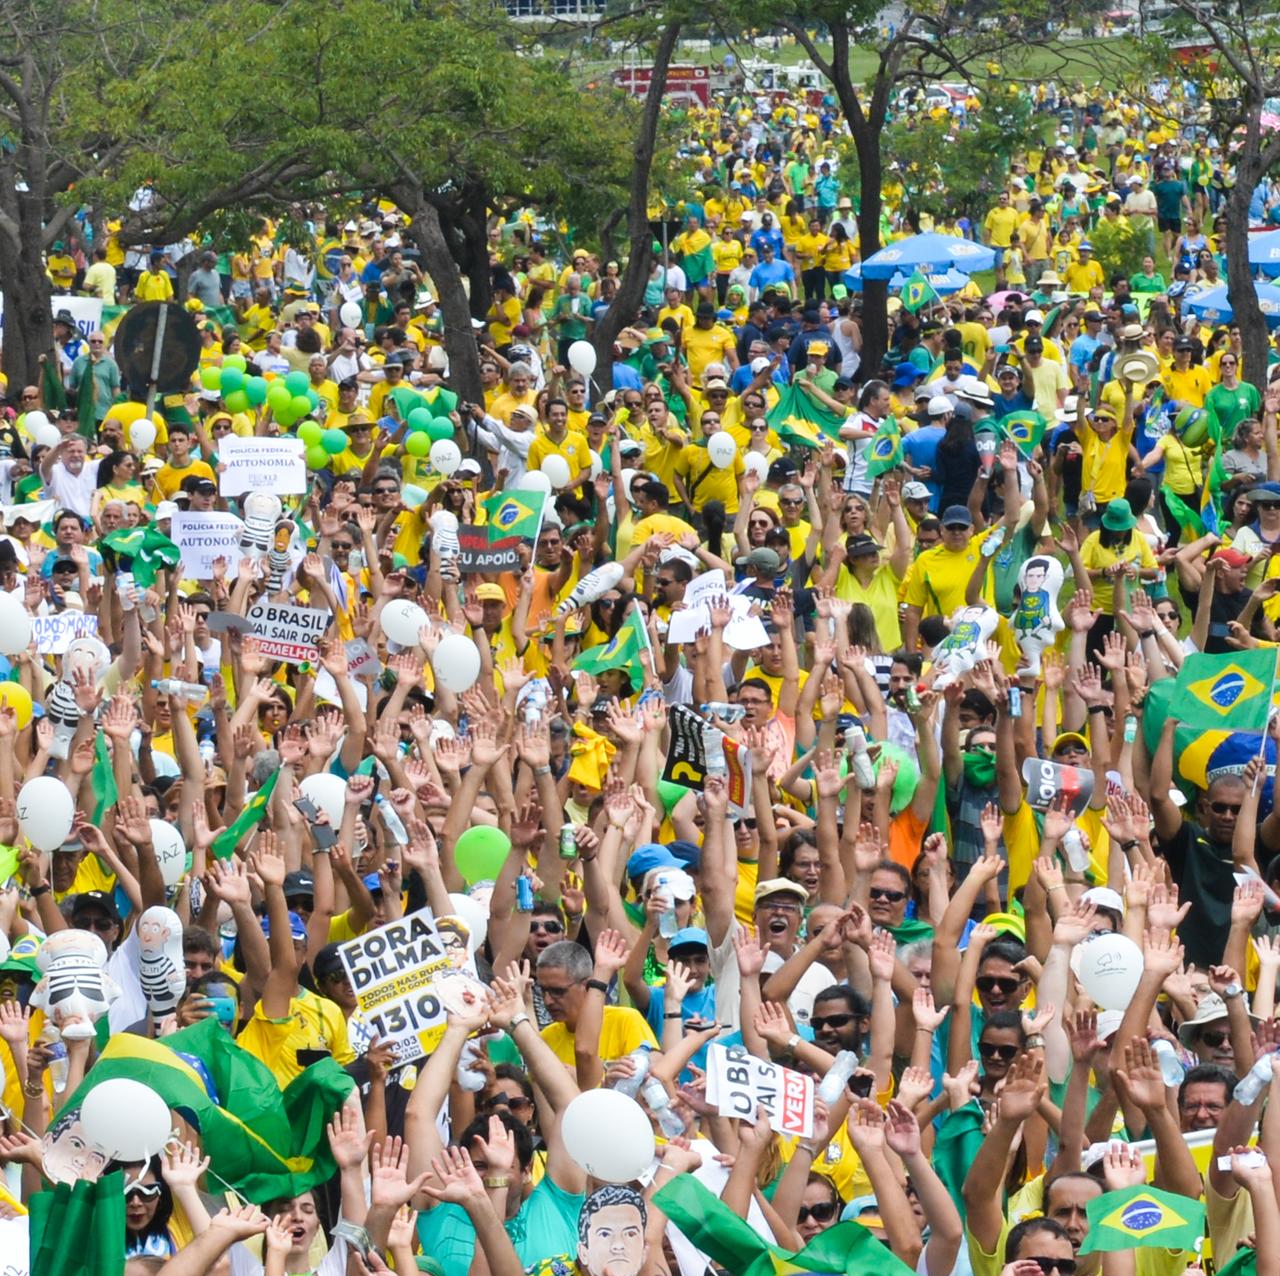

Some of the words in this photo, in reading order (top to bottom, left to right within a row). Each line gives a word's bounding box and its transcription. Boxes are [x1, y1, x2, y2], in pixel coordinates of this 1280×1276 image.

[229, 458, 295, 467] AUTONOMIA
[182, 522, 214, 531] POLÍCIA
[180, 536, 239, 548] AUTONOM
[250, 606, 264, 619] O
[266, 608, 324, 631] BRASIL
[270, 626, 299, 643] SAIR
[259, 640, 319, 663] RMELHO
[347, 651, 371, 672] FOR
[341, 916, 435, 969] FORA
[352, 938, 443, 991] DILMA
[361, 983, 395, 1004] TODOS
[396, 976, 418, 993] NAS
[419, 961, 448, 983] RUAS
[363, 992, 397, 1010] CONTRA
[398, 988, 409, 998] O
[409, 977, 435, 993] GOVE
[733, 1091, 753, 1115] O
